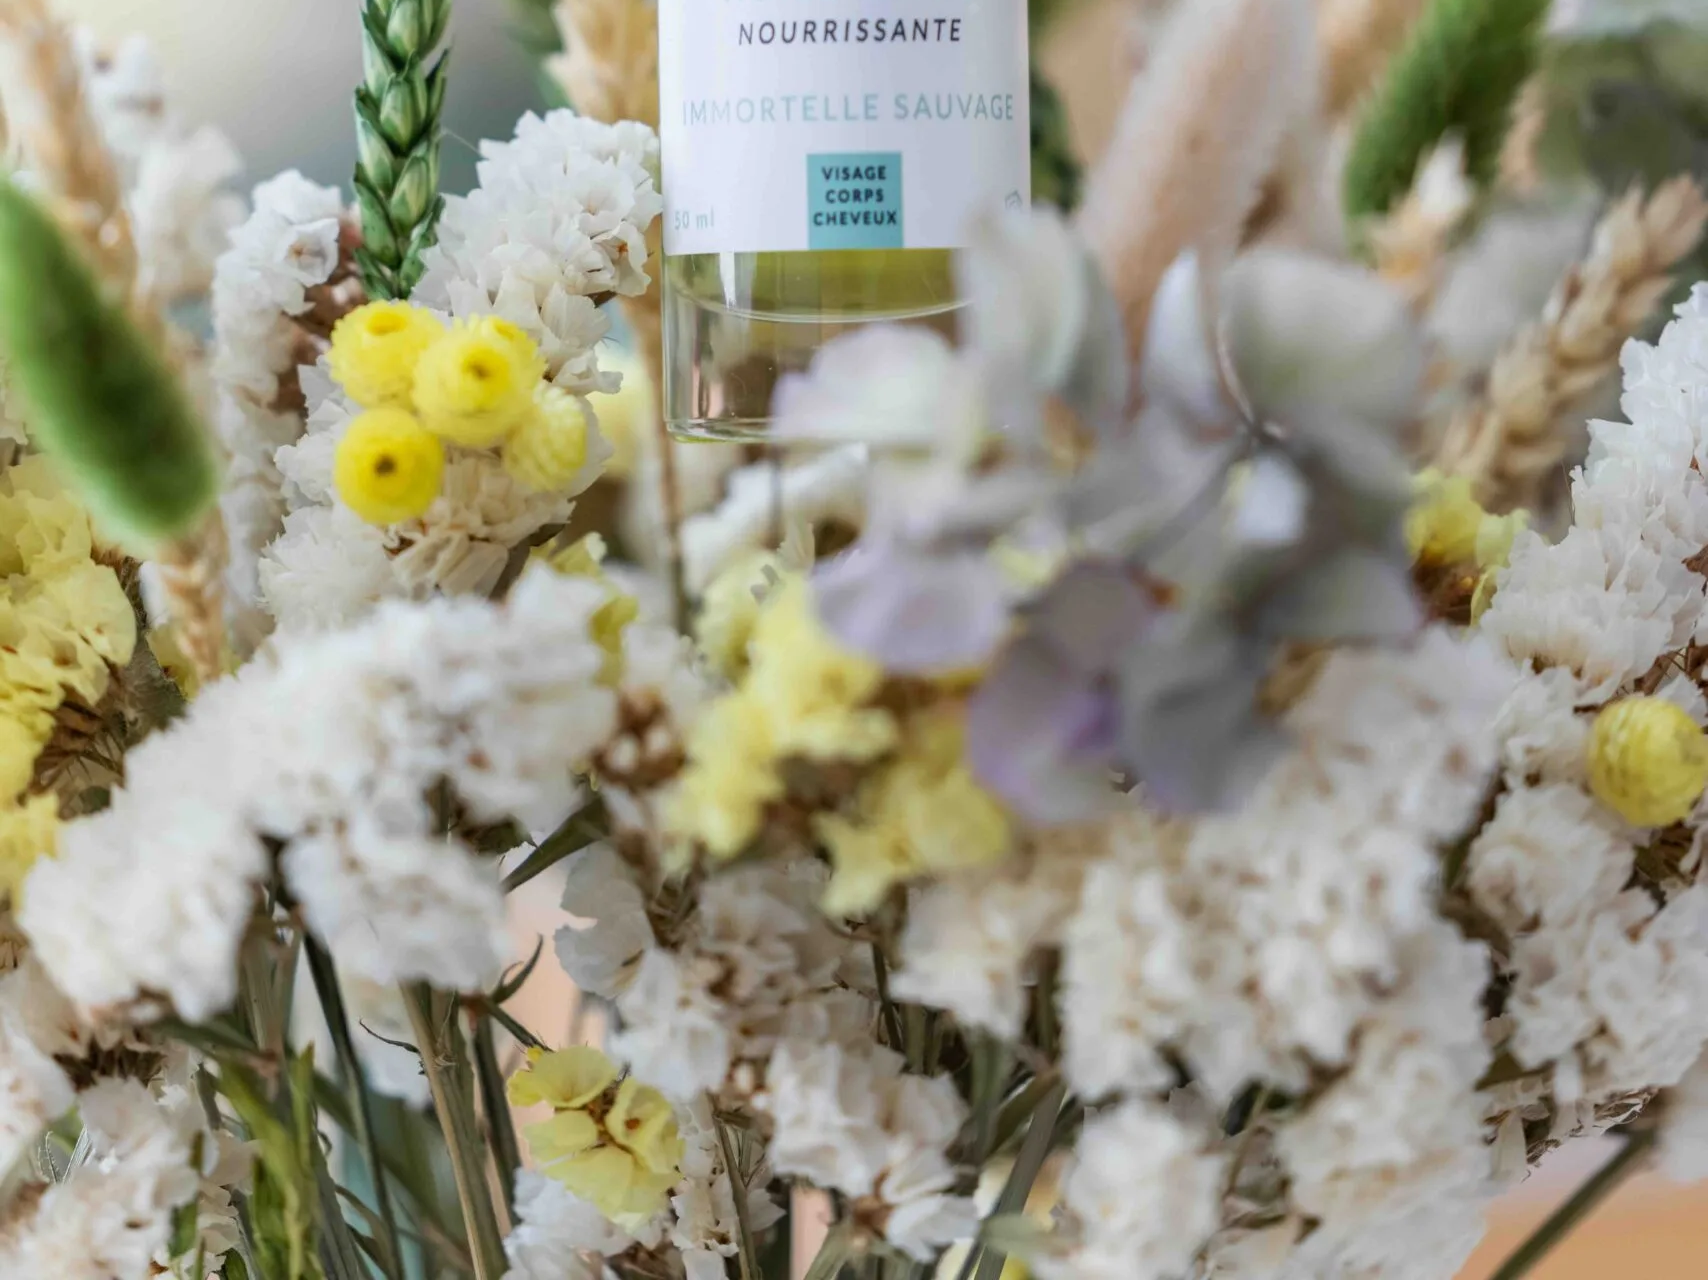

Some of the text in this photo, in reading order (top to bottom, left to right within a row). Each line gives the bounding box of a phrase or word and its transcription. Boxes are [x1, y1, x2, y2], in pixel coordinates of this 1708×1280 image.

[738, 18, 961, 45] NOURRISSANTE
[682, 93, 1013, 125] IMMORTELLE SAUVAGE
[821, 165, 888, 181] VISAGE
[825, 188, 885, 204] CORPS
[813, 211, 897, 226] CHEVEUX
